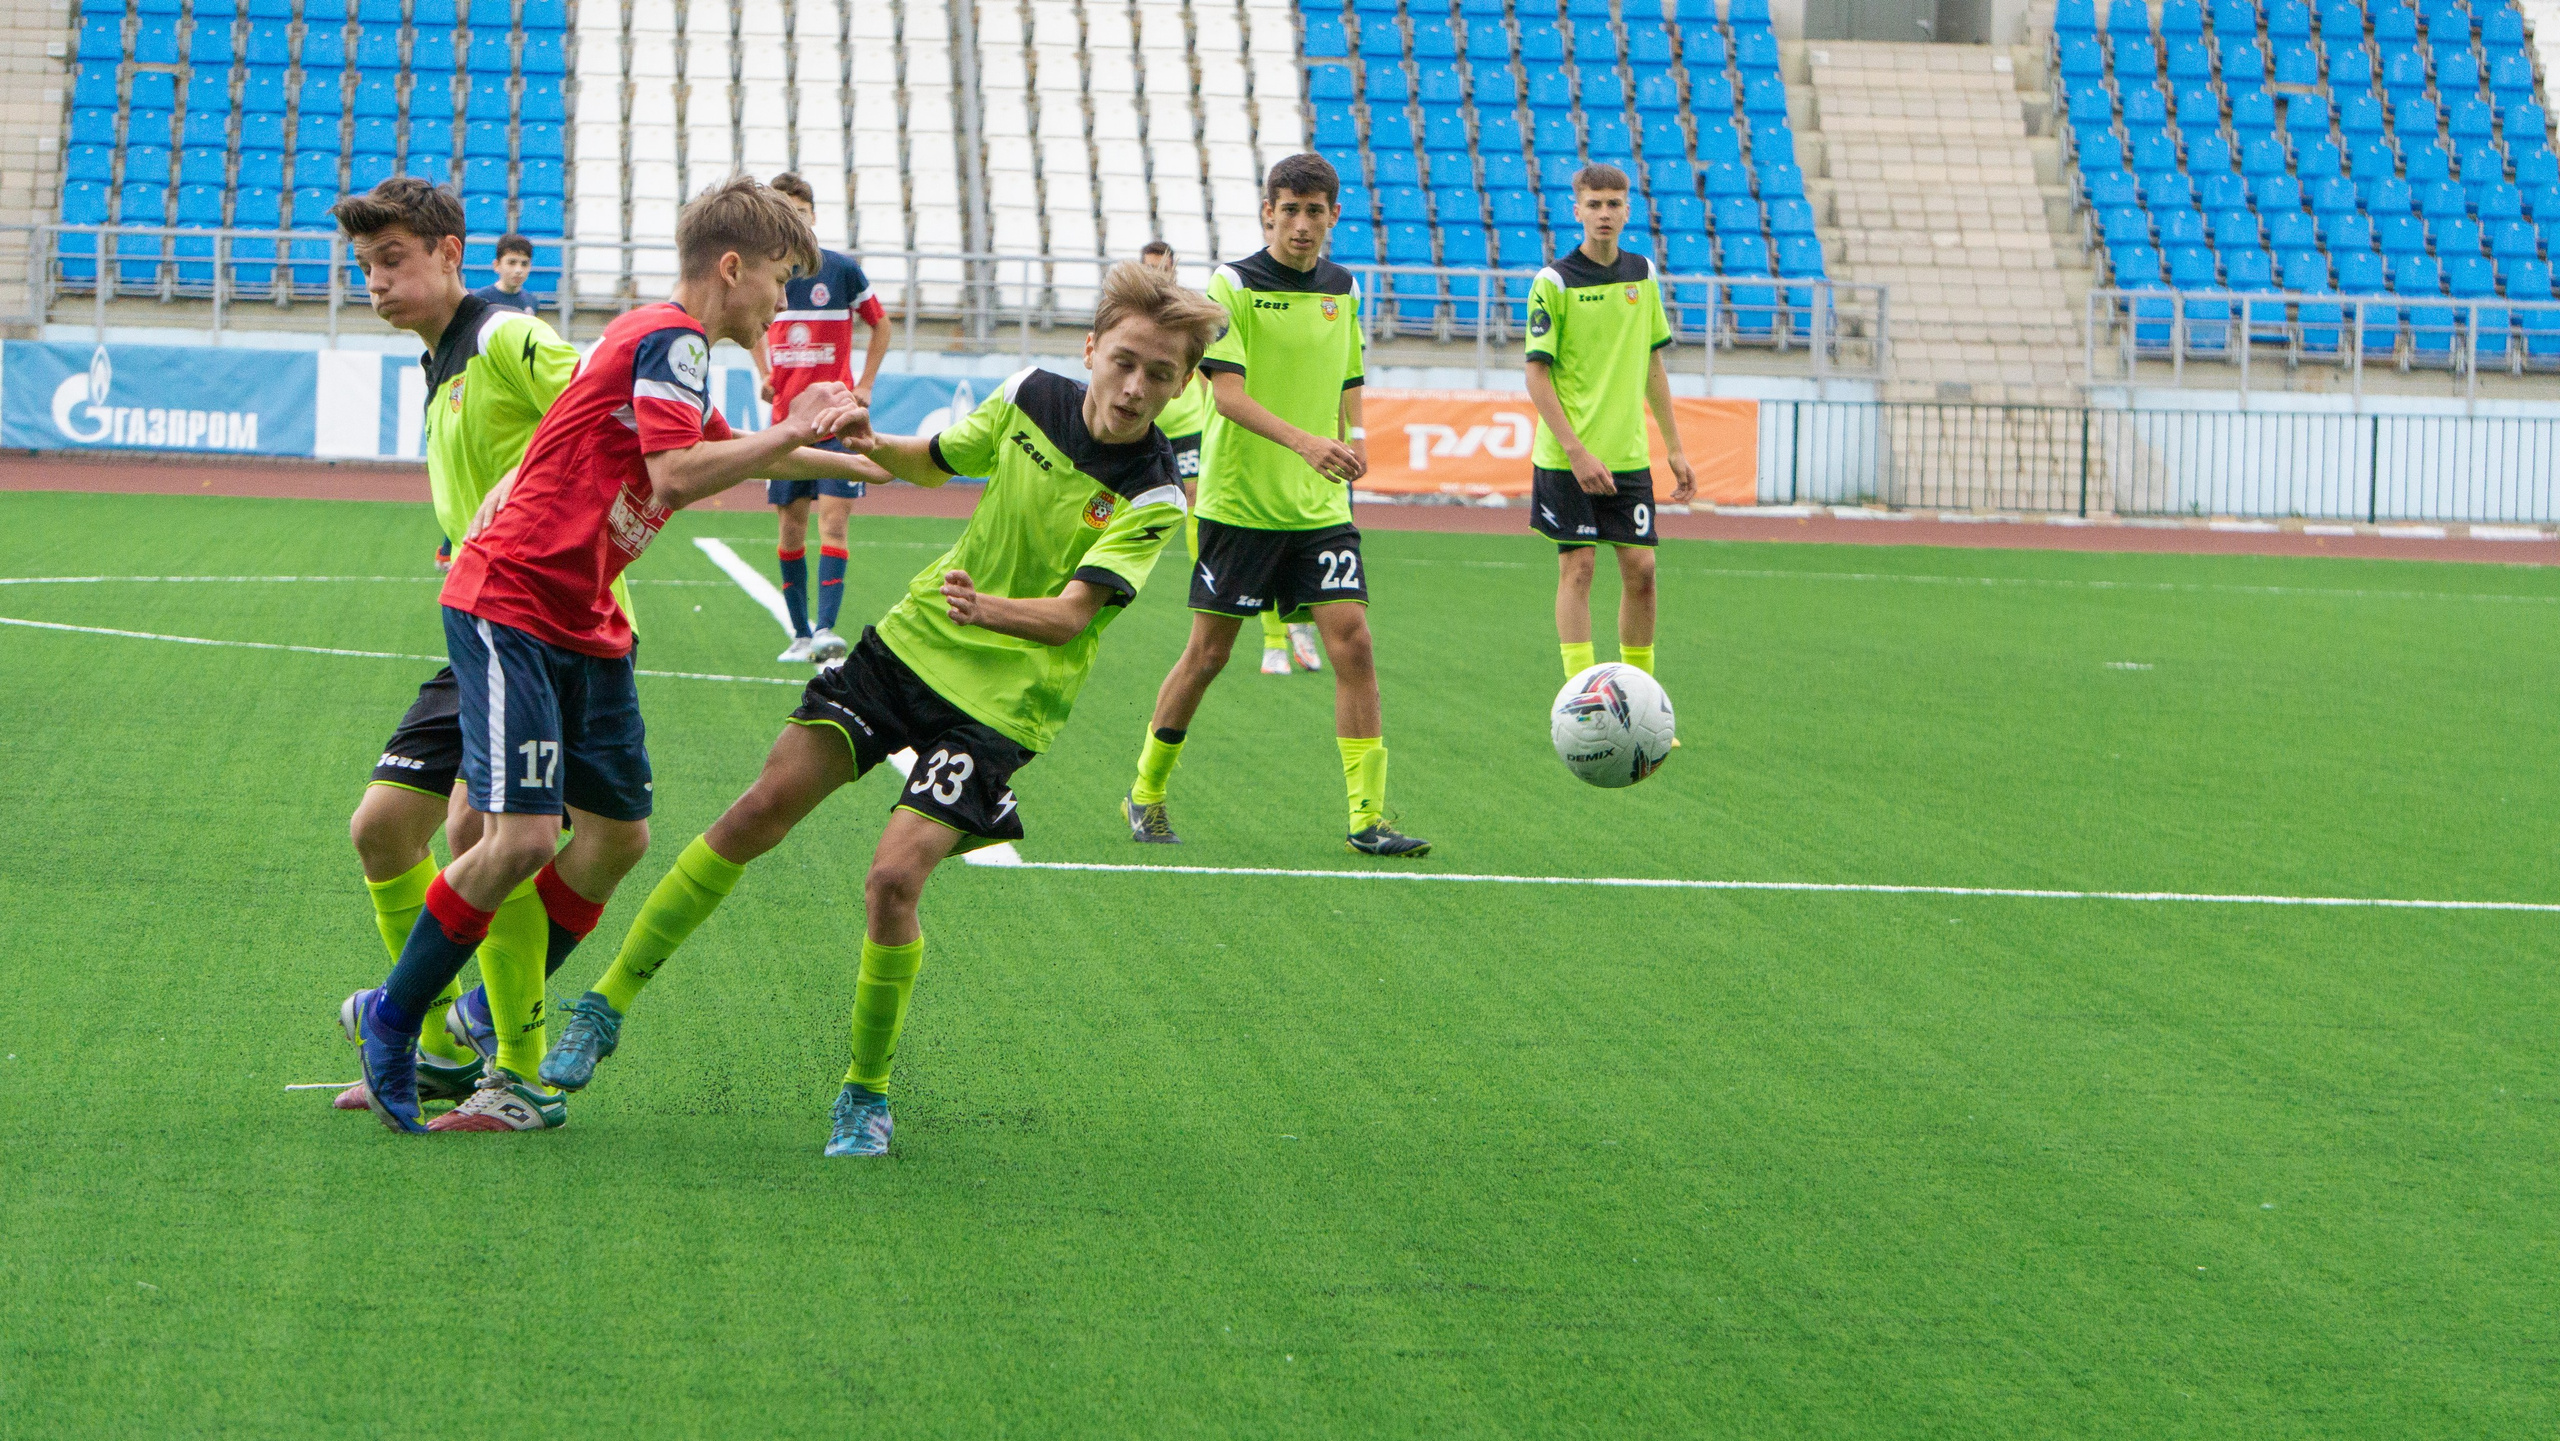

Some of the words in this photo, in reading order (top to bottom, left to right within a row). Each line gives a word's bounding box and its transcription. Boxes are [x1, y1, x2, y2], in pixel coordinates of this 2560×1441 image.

[1254, 299, 1289, 310] Zeus
[1579, 293, 1604, 302] Zeus
[112, 407, 258, 449] ГАЗПРОМ
[1010, 430, 1053, 472] Zeus
[1633, 503, 1650, 537] 9
[1318, 550, 1360, 589] 22
[518, 740, 558, 788] 17
[1567, 747, 1615, 762] DEMIX
[910, 749, 974, 805] 33
